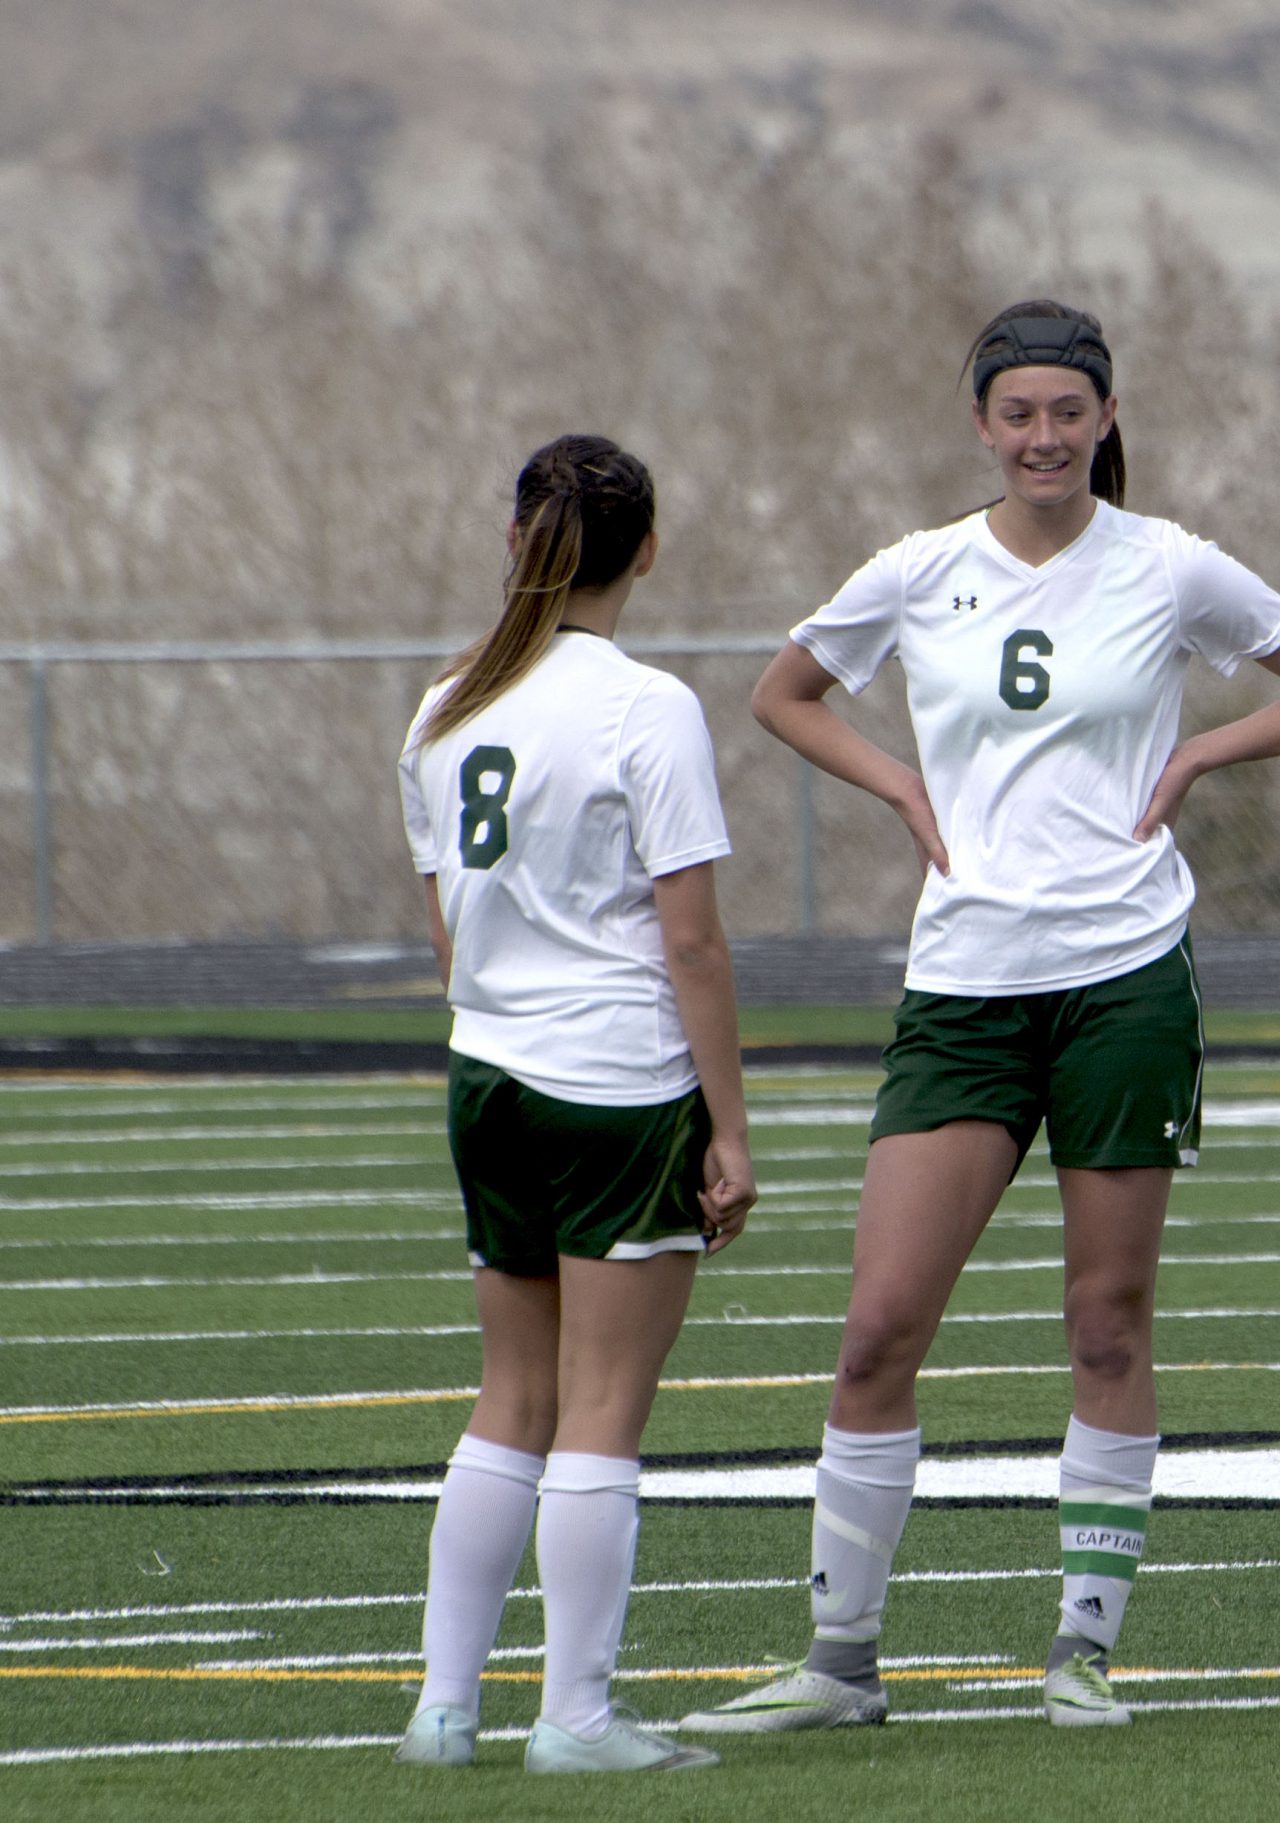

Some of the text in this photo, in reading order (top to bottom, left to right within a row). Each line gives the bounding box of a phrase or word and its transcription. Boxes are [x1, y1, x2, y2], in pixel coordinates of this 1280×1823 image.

[999, 629, 1054, 711] 6
[459, 745, 516, 870] 8
[1076, 1532, 1142, 1554] CAPTAIN
